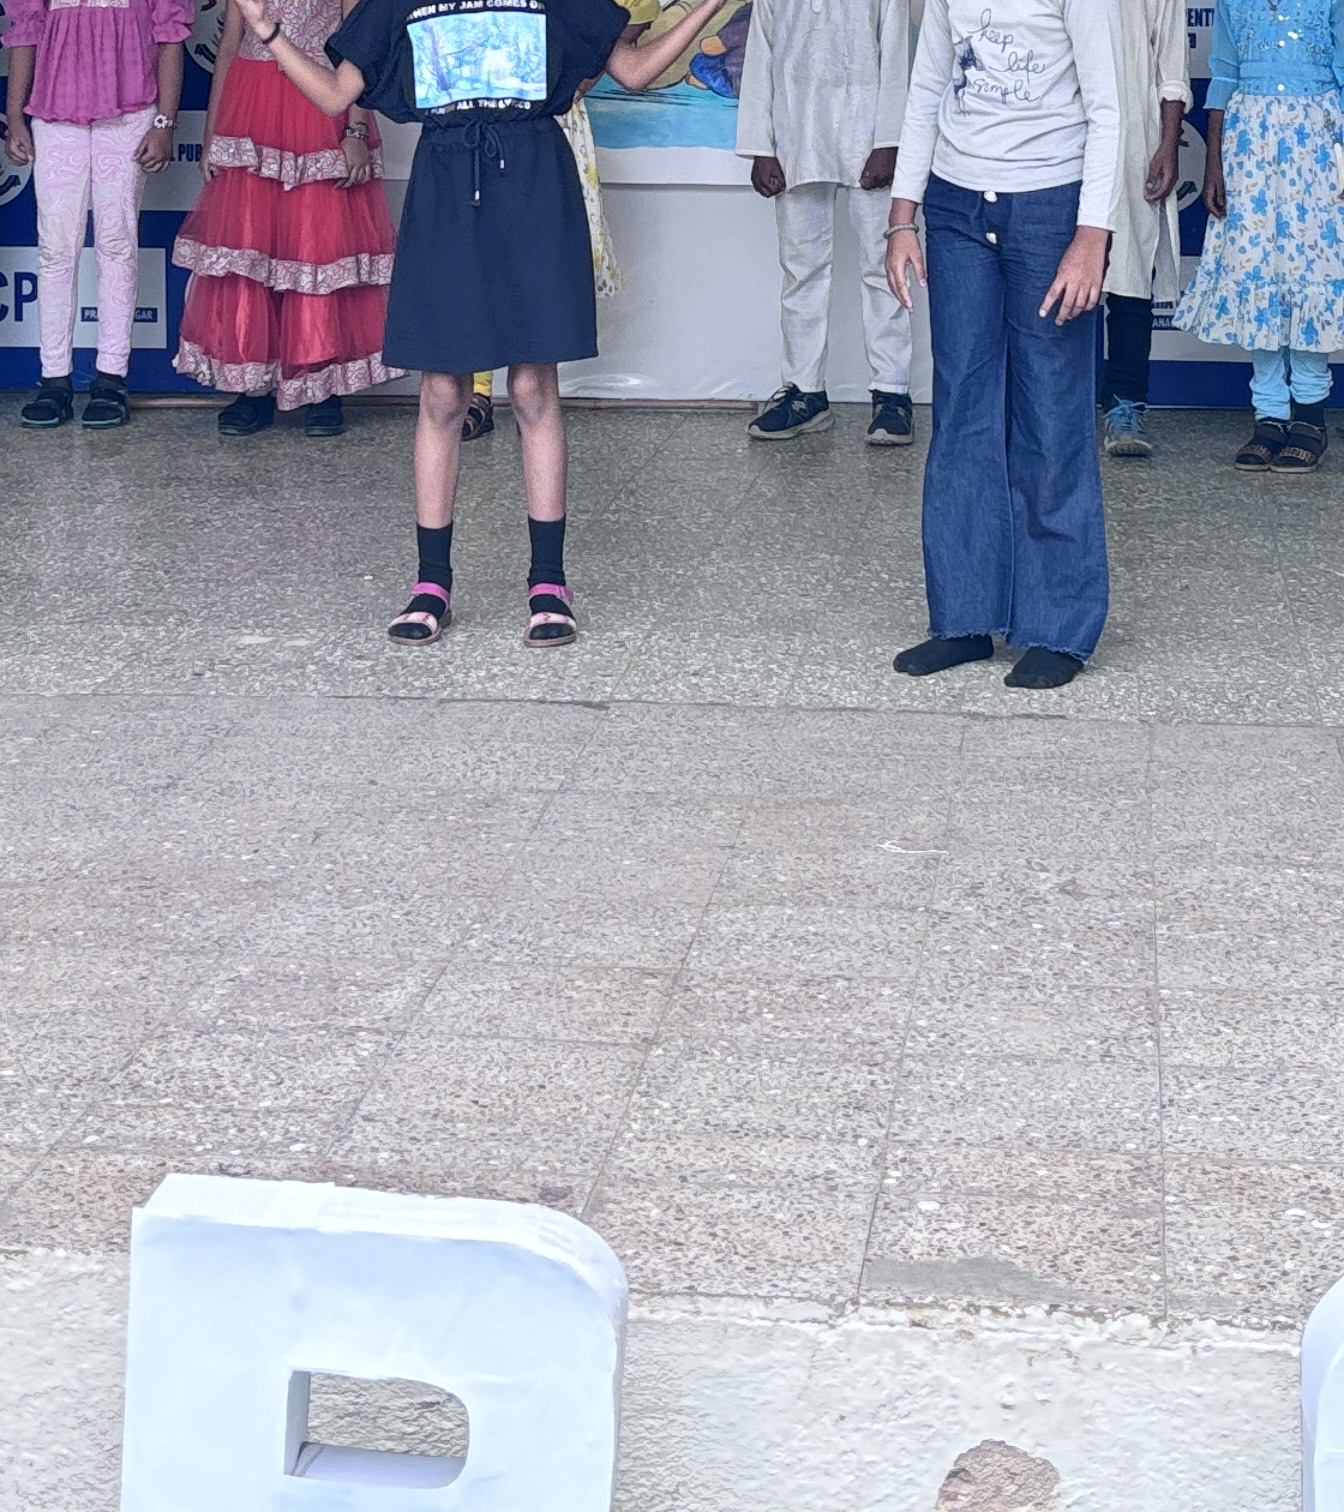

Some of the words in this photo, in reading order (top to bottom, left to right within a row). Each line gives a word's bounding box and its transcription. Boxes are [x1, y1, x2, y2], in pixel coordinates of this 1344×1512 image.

[438, 2, 456, 13] MY
[459, 0, 483, 10] JAM
[988, 49, 1045, 85] life
[179, 143, 202, 163] PUB
